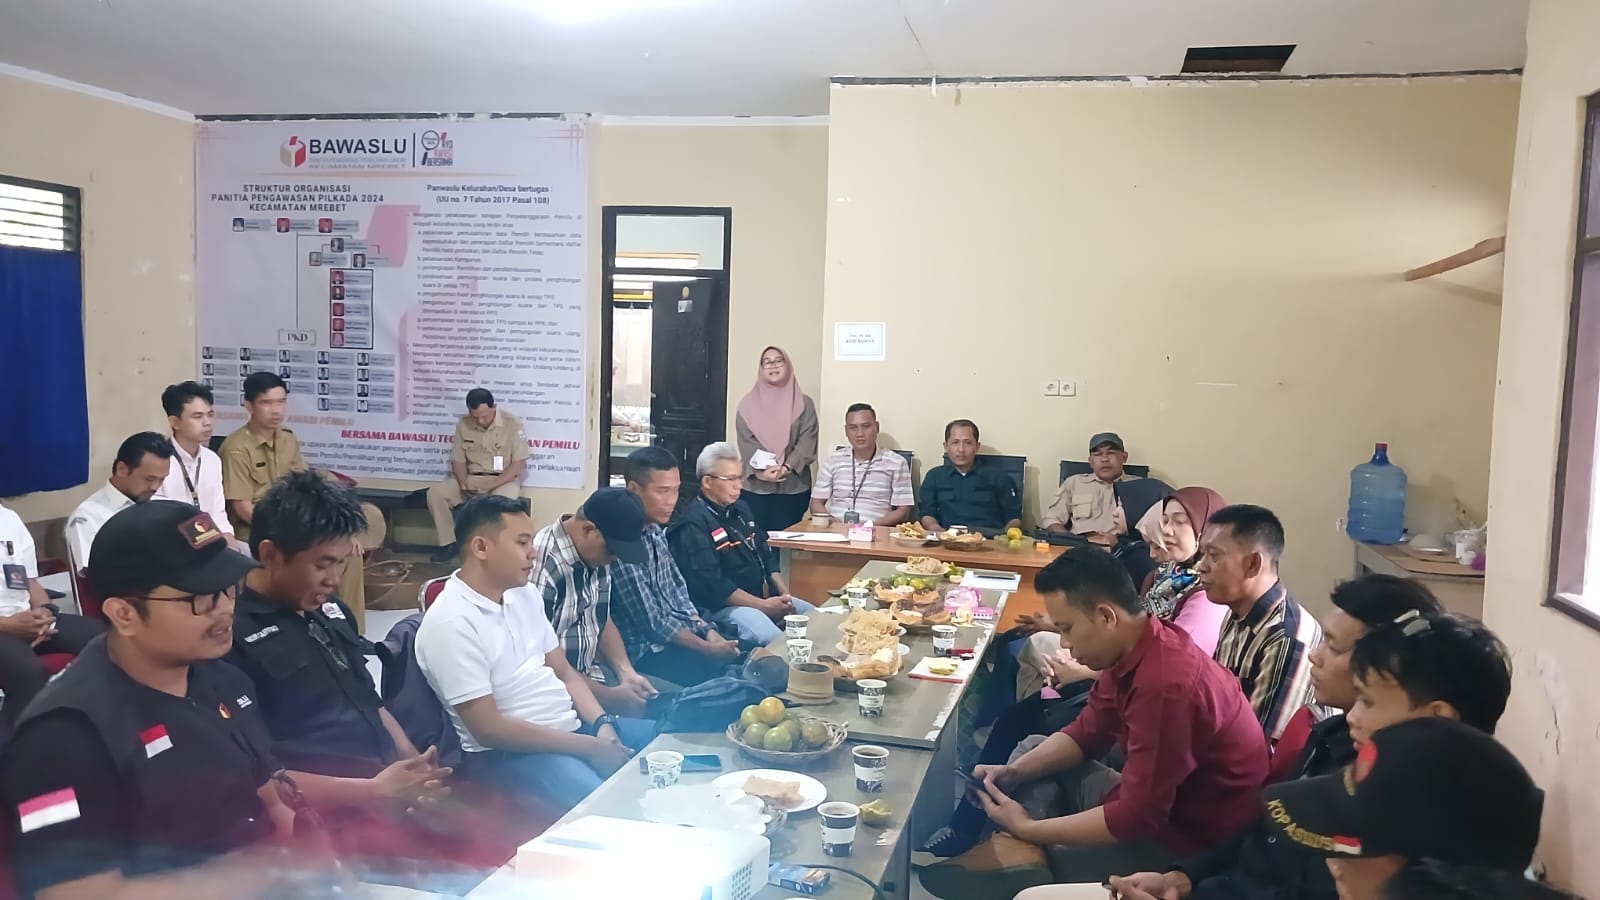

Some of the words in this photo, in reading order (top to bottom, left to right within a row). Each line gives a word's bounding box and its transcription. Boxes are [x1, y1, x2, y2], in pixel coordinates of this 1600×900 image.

[309, 138, 406, 154] BAWASLU
[243, 184, 291, 192] STRUKTUR
[294, 184, 351, 193] ORGANISASI
[427, 184, 460, 192] Panwaslu
[461, 184, 517, 193] Kelurahan/Desa
[518, 186, 550, 194] bertugas
[211, 194, 249, 202] PANITIA
[251, 194, 316, 202] PENGAWASAN
[318, 194, 358, 202] PILKADA
[361, 194, 384, 202] 2024
[470, 196, 492, 204] Tahun
[492, 196, 511, 204] 2017
[512, 196, 532, 204] Pasal
[249, 204, 307, 212] KECAMATAN
[310, 204, 346, 212] MREBET
[288, 333, 308, 342] PKD
[341, 430, 386, 440] BERSAMA
[388, 431, 436, 442] BAWASLU
[542, 440, 580, 450] PEMILU
